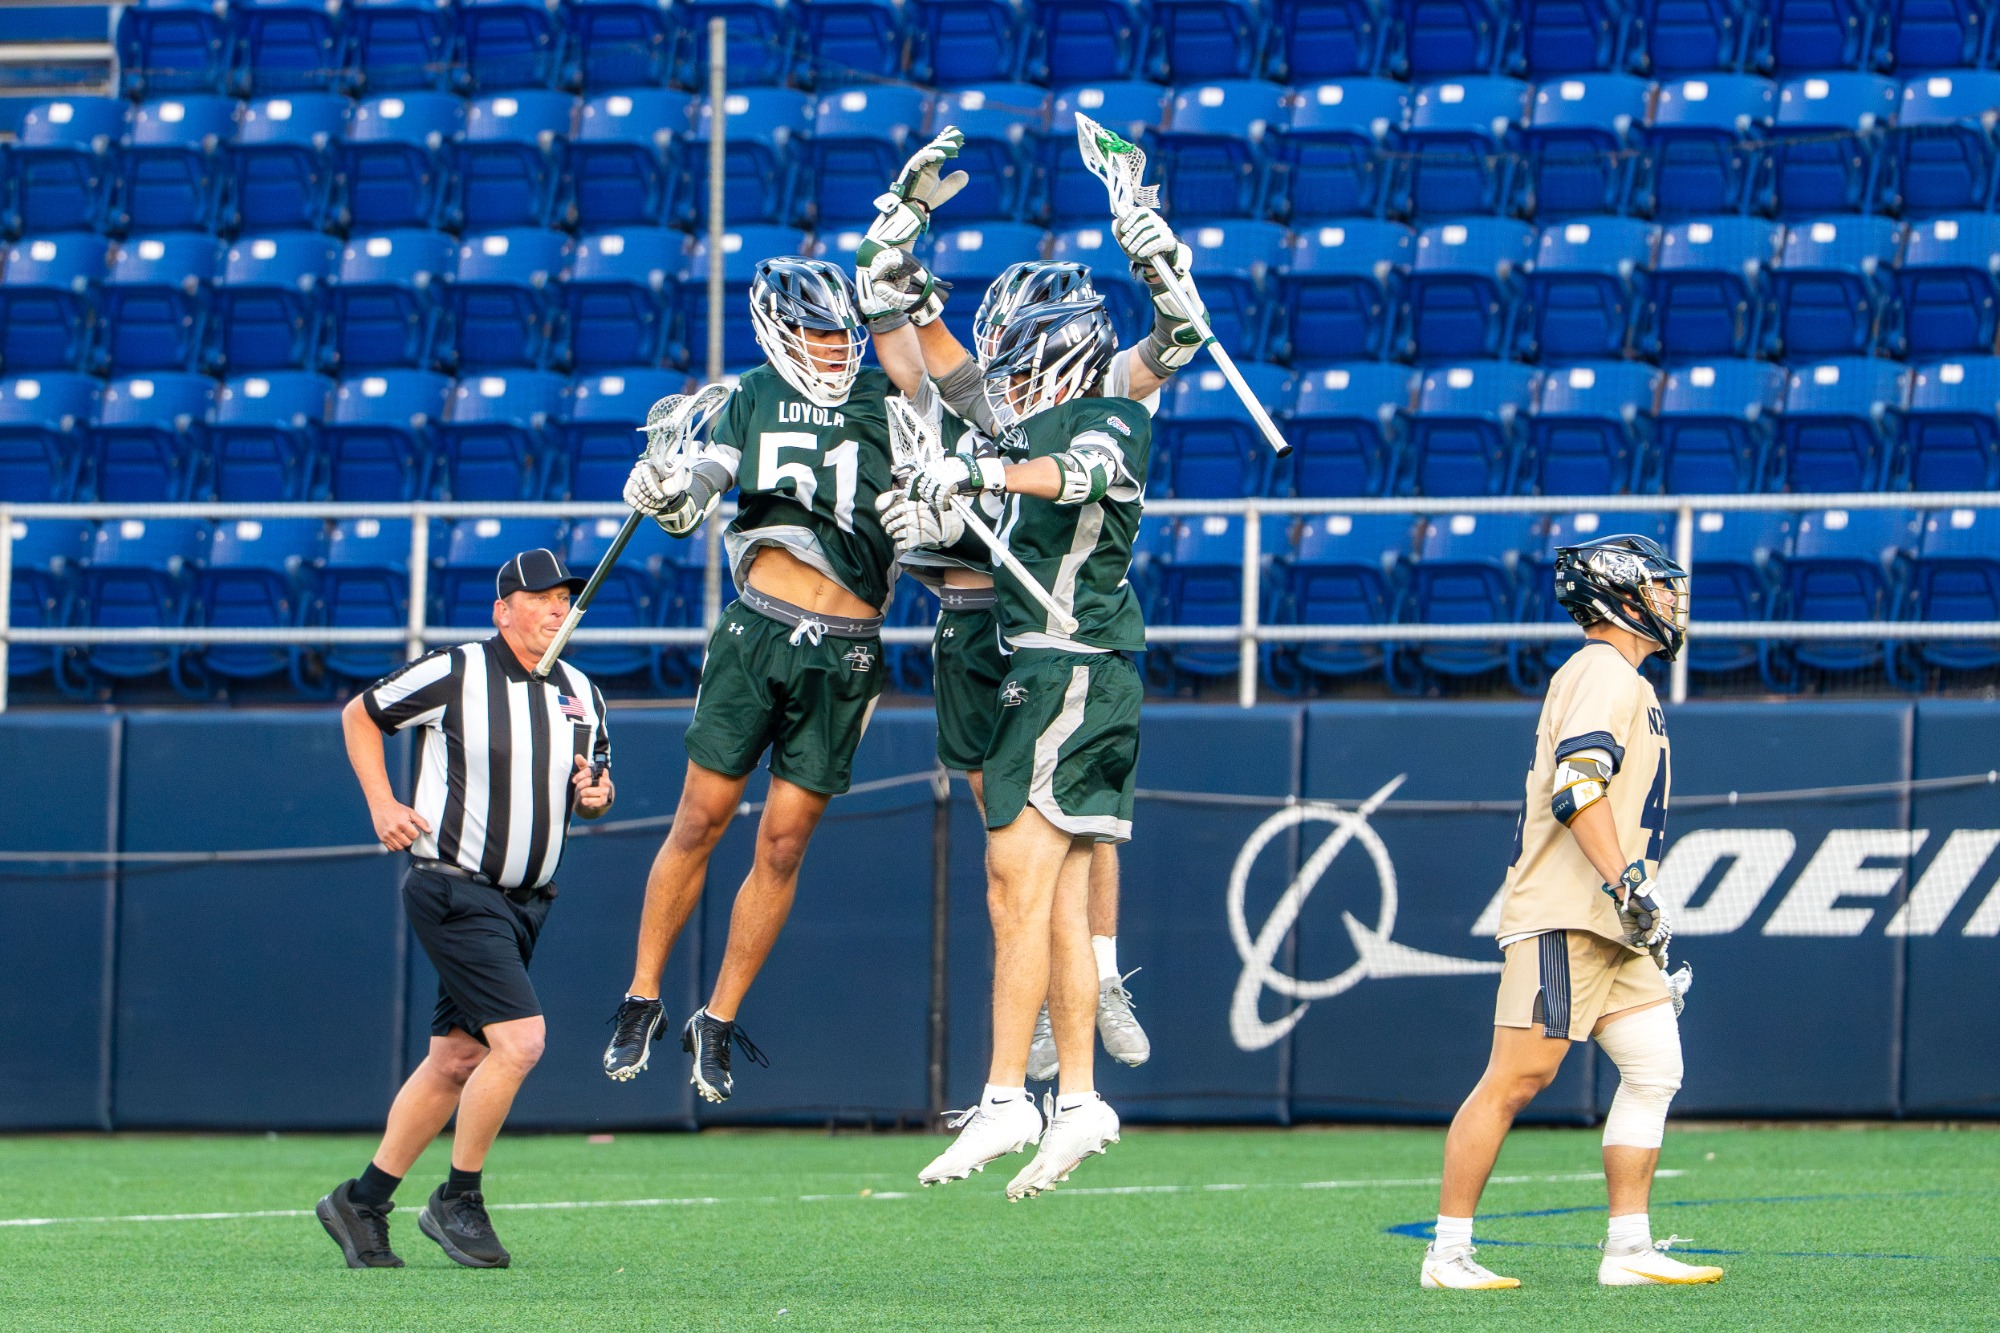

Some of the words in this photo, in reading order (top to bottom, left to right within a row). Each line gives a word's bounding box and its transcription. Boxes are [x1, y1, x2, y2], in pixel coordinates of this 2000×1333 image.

[778, 401, 846, 428] LOYOLA
[757, 431, 859, 535] 51
[1566, 581, 1576, 591] 46
[1471, 829, 2000, 937] OEI
